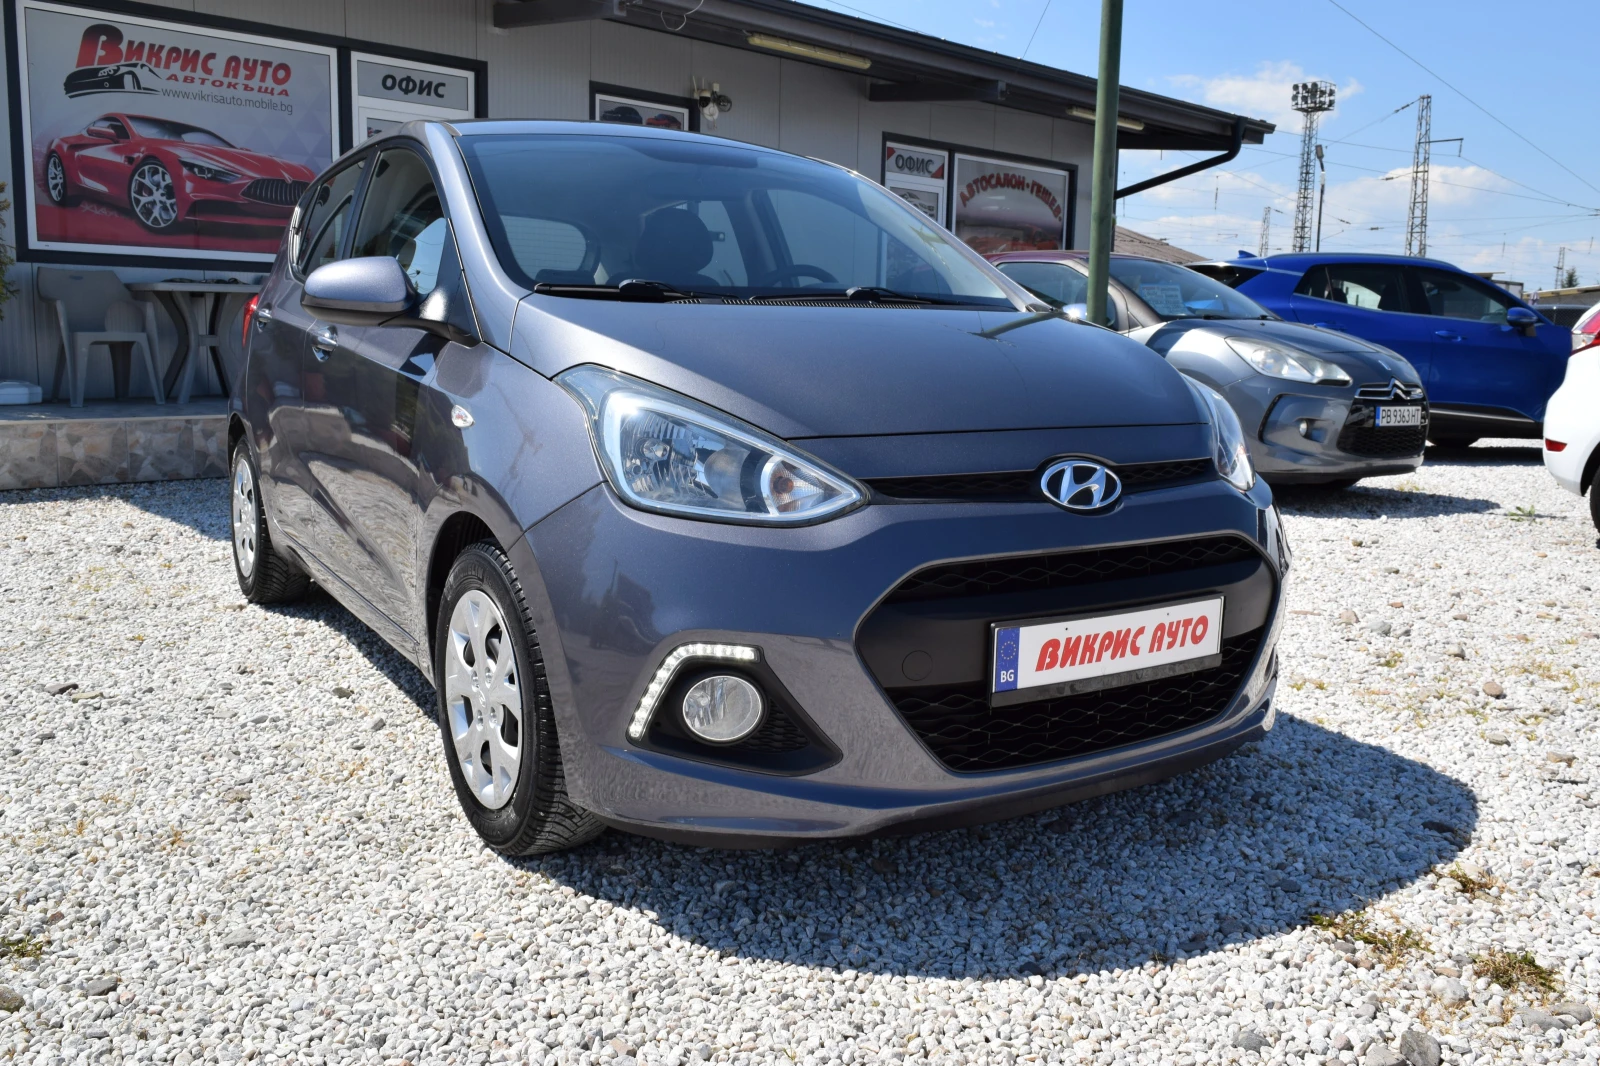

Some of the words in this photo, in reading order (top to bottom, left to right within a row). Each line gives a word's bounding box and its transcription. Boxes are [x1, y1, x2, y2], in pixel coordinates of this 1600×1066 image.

[223, 55, 292, 86] АУТО
[165, 73, 290, 97] АВТОКЪЩА
[381, 74, 446, 99] ОФИС
[161, 87, 293, 115] www.vikrisauto.mobile.bg
[895, 154, 935, 174] ОФИС
[959, 173, 1025, 208] АВТОСАЛОН
[1393, 409, 1410, 424] 9363
[1035, 626, 1146, 672] ВИКРИС
[1148, 615, 1209, 654] АУТО
[1000, 669, 1015, 683] BG
